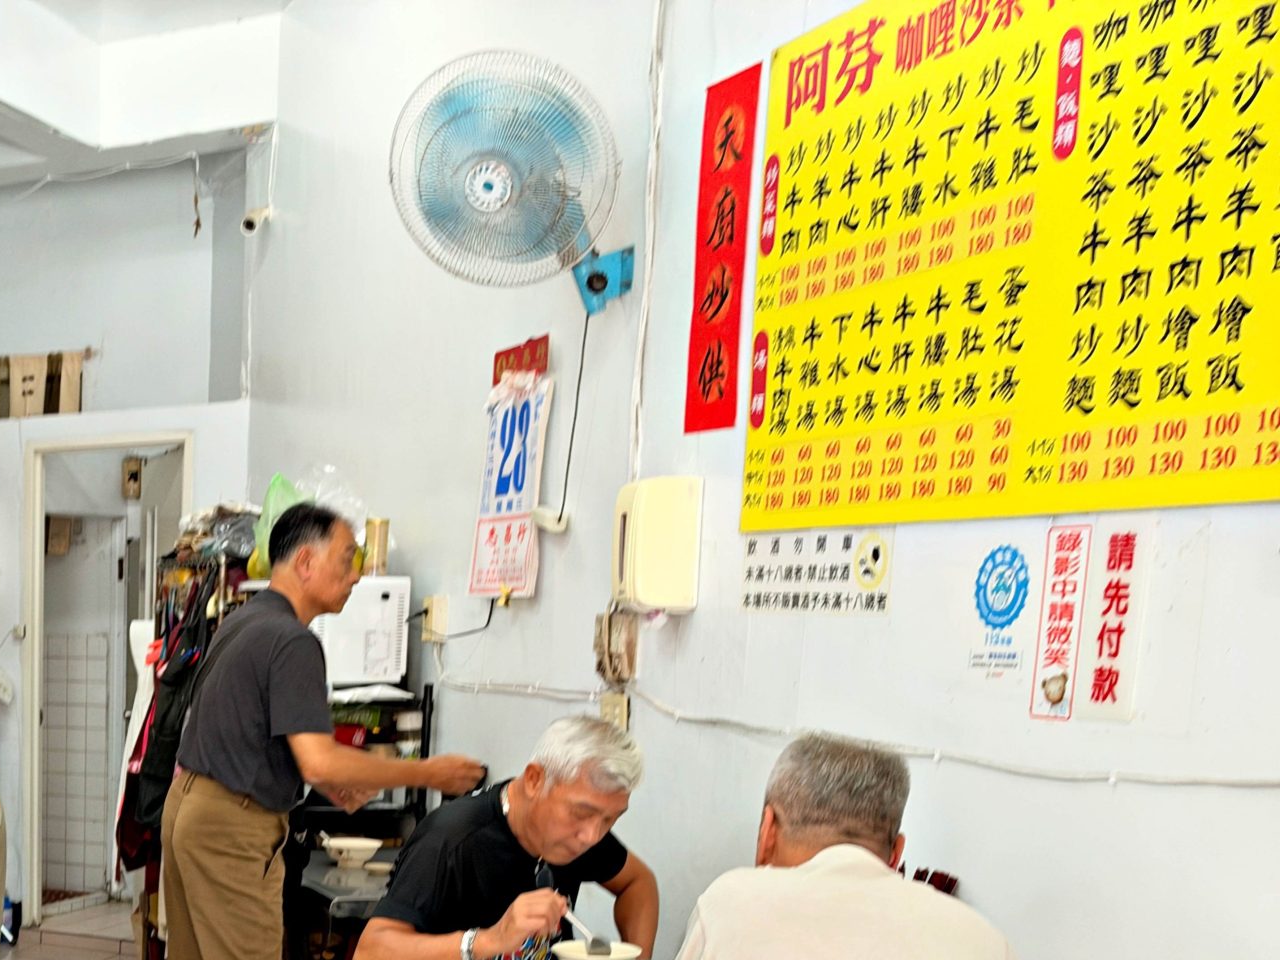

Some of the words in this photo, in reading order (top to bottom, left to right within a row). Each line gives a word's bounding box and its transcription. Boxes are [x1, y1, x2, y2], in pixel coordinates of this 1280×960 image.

[784, 16, 887, 130] 阿芬
[808, 128, 836, 247] 炒羊肉
[836, 115, 866, 234] 炒牛心
[932, 72, 968, 207] 炒下水
[779, 263, 800, 286] 100
[805, 255, 827, 277] 100
[834, 247, 857, 270] 100
[863, 237, 887, 260] 100
[897, 226, 921, 250] 100
[929, 217, 956, 240] 100
[969, 205, 997, 231] 100
[1006, 192, 1035, 220] 100
[780, 140, 808, 259] 炒牛肉
[824, 311, 854, 427] 下水湯
[854, 302, 883, 424] 牛心湯
[990, 265, 1030, 404] 蛋花湯
[767, 468, 785, 488] 120
[794, 466, 813, 486] 120
[821, 463, 842, 482] 120
[850, 459, 872, 480] 120
[881, 455, 904, 476] 120
[913, 452, 938, 473] 120
[949, 448, 975, 470] 120
[990, 444, 1008, 467] 60
[770, 447, 784, 465] 60
[798, 443, 812, 461] 60
[825, 440, 841, 458] 60
[855, 437, 871, 455] 60
[886, 432, 902, 451] 60
[920, 427, 937, 447] 60
[955, 423, 974, 443] 60
[993, 417, 1012, 440] 30
[1058, 460, 1089, 484] 130
[1102, 455, 1135, 480] 130
[1148, 450, 1184, 476] 130
[1198, 445, 1237, 471] 130
[1060, 430, 1092, 455] 100
[1105, 424, 1139, 450] 100
[1152, 418, 1187, 445] 100
[1203, 411, 1241, 439] 100
[747, 534, 853, 556] 飲酒勿開車
[1043, 531, 1082, 668] 錄影中請微笑
[1090, 531, 1137, 704] 請先付款
